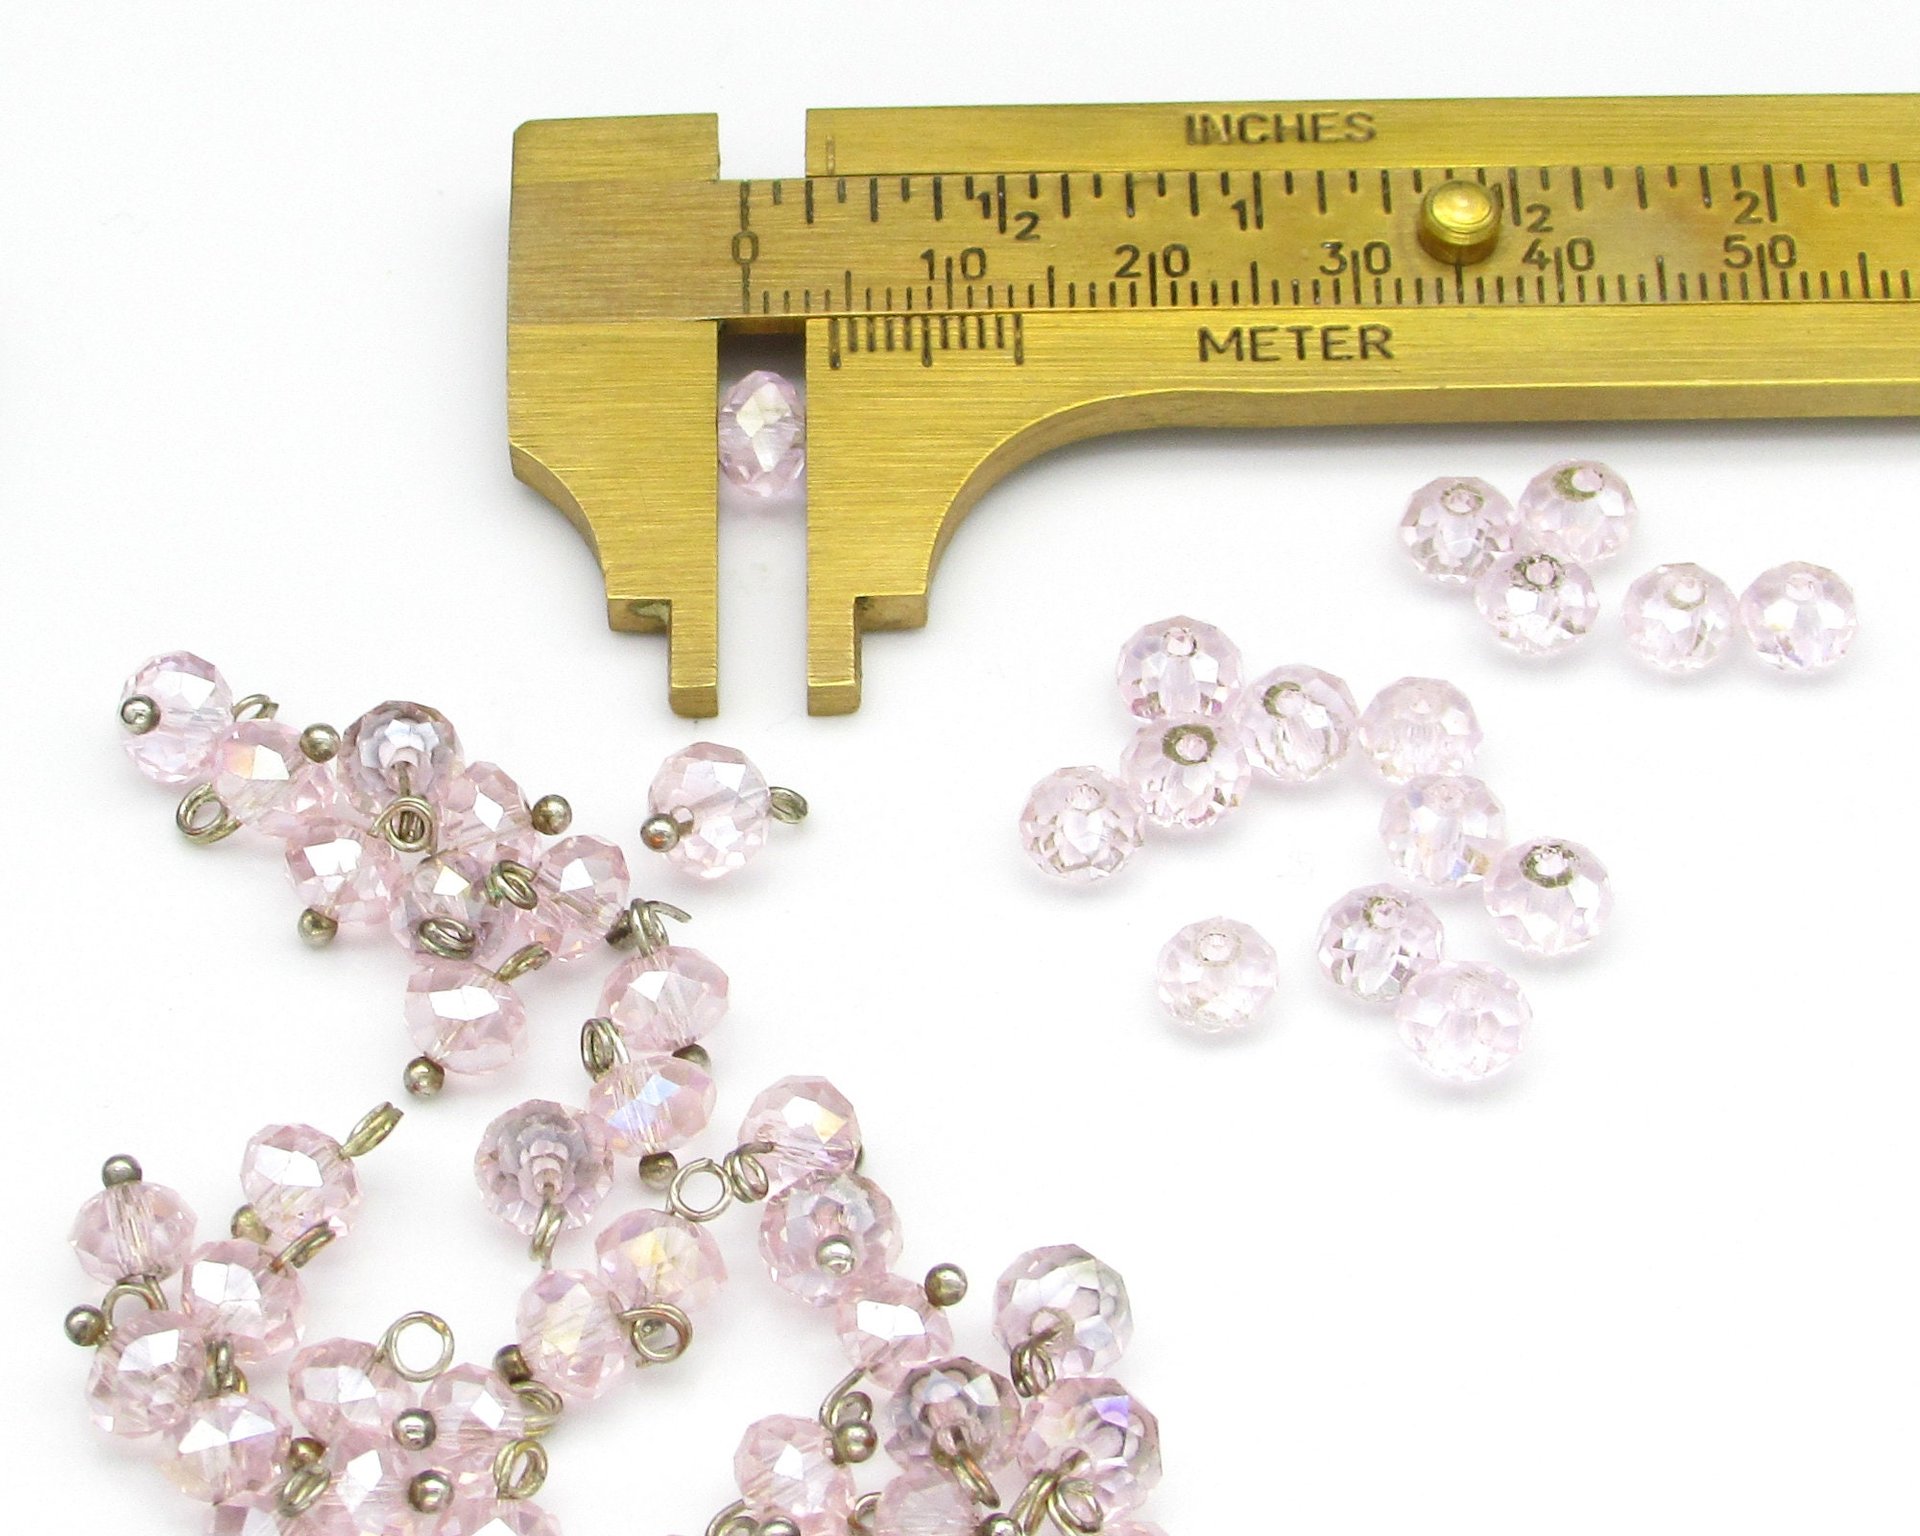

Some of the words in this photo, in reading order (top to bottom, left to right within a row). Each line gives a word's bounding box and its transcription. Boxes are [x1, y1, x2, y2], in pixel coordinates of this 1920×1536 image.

[1186, 111, 1376, 146] INCHES
[1230, 199, 1248, 231] 1
[1734, 190, 1763, 224] 2
[1198, 323, 1394, 362] METER
